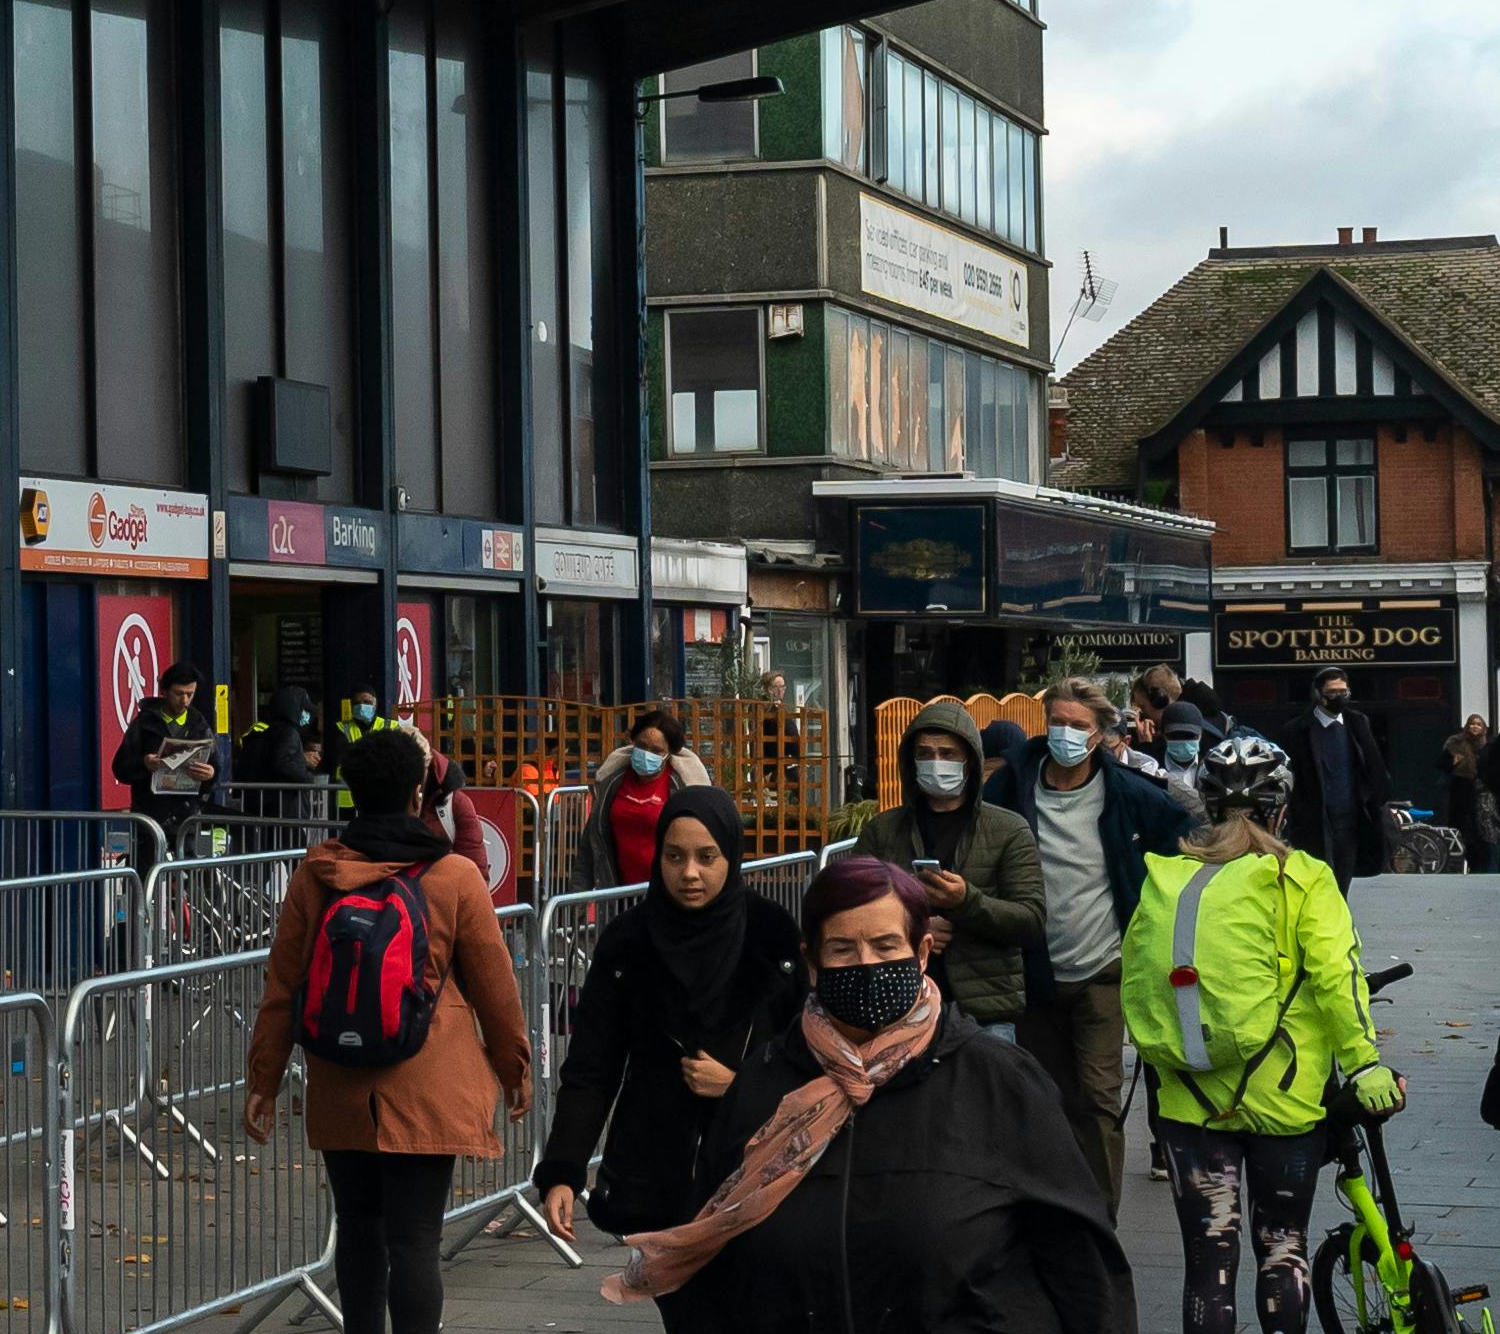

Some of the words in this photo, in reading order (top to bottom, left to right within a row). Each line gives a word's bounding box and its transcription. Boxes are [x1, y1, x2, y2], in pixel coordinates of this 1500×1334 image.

[108, 510, 148, 550] Gadget
[272, 515, 296, 555] c2c
[333, 516, 376, 556] Barking
[1318, 614, 1354, 628] THE
[1053, 633, 1175, 648] ACCOMMODATION
[1228, 628, 1364, 648] SPOTTED
[1372, 626, 1443, 646] DOG
[1294, 648, 1375, 661] BARKING
